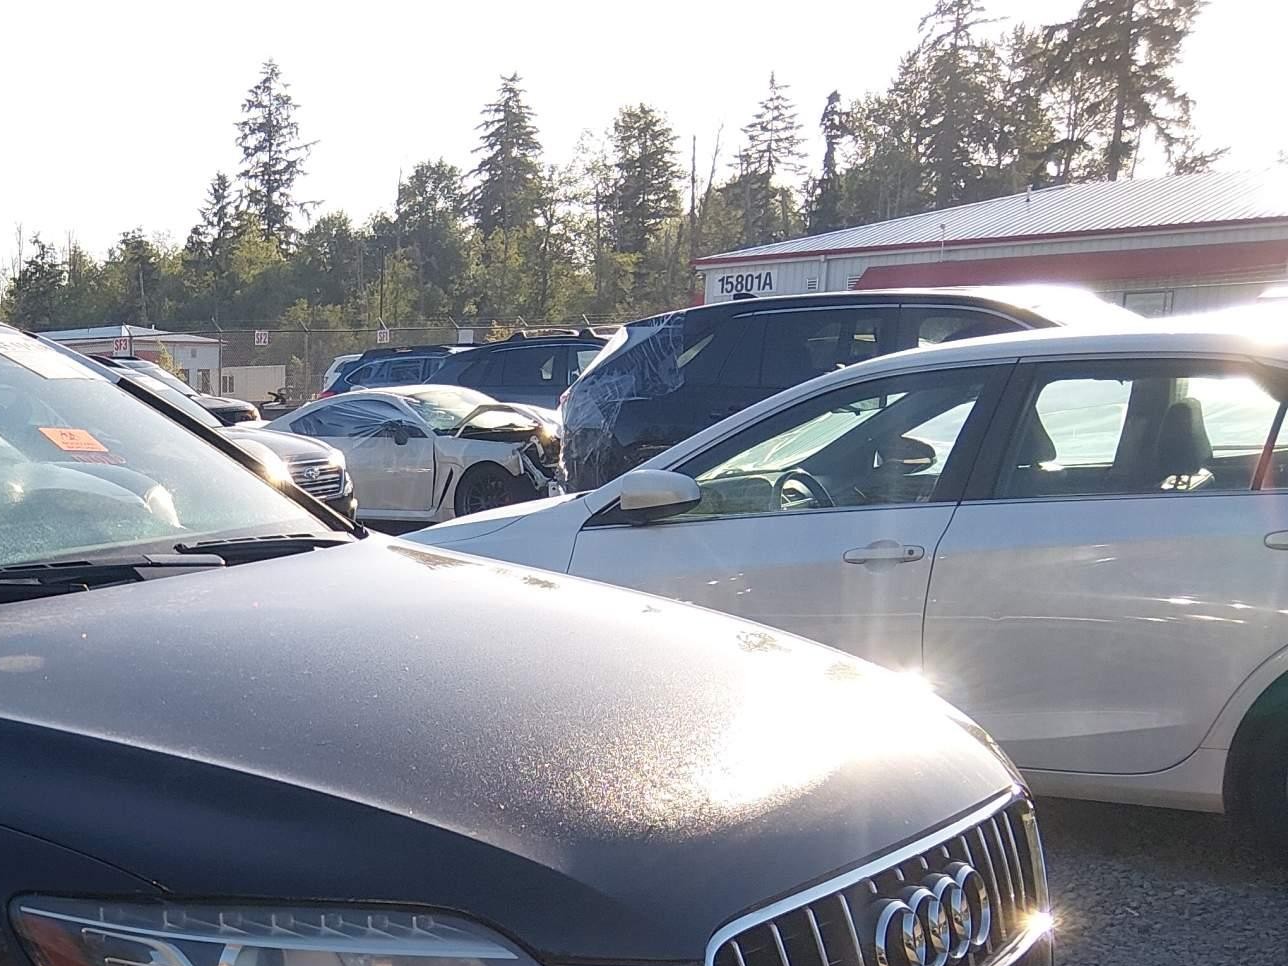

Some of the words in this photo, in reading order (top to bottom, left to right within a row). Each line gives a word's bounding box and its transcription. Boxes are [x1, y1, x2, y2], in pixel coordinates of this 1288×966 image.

[718, 271, 773, 294] 15801A
[255, 332, 267, 344] SF2
[114, 339, 128, 351] SF3
